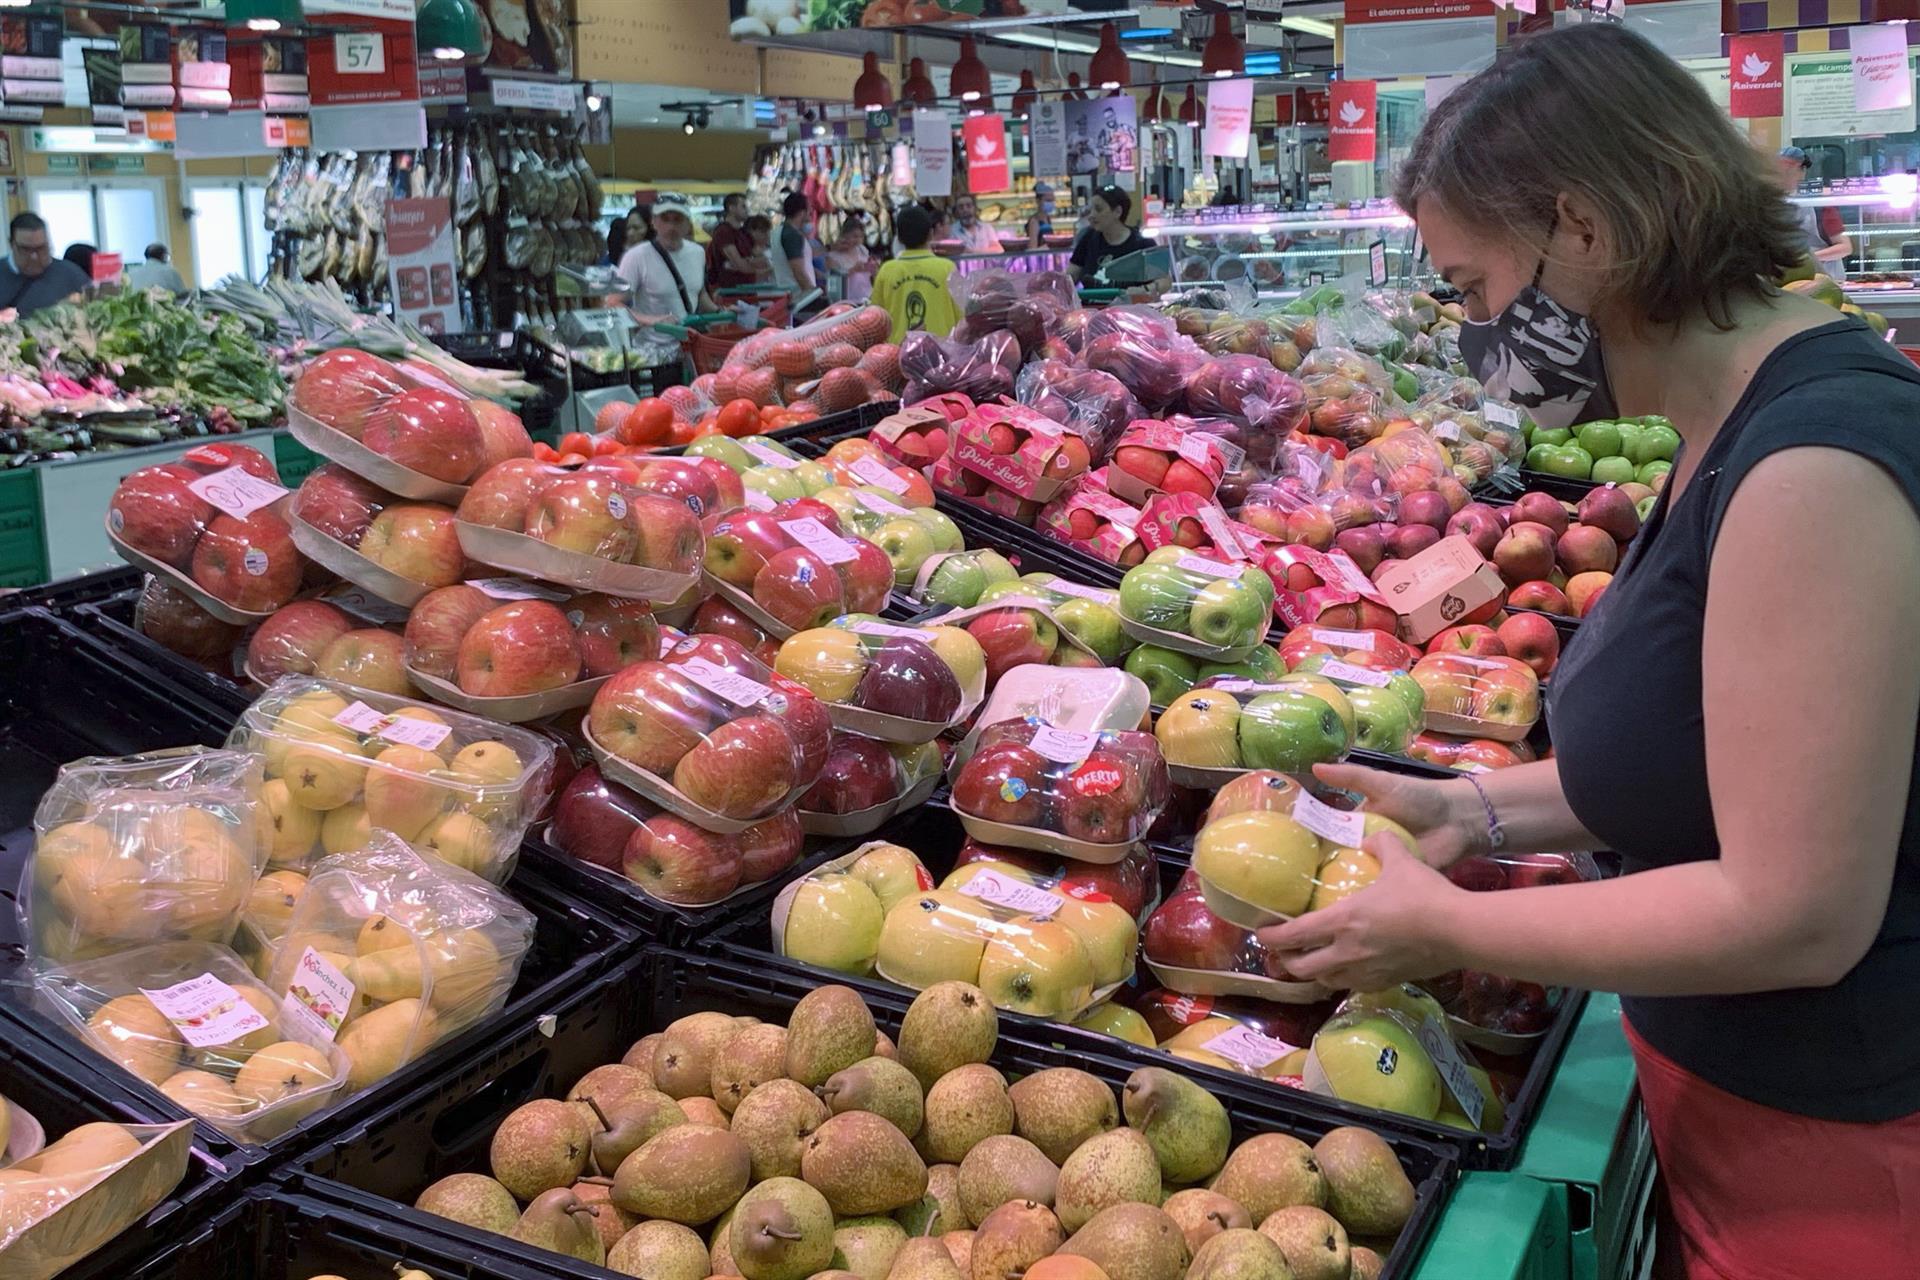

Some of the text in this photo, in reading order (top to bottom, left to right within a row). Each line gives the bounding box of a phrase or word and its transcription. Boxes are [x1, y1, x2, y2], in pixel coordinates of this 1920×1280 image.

[1378, 8, 1405, 17] ahorro
[1445, 3, 1470, 14] precio
[347, 45, 373, 67] 57
[1856, 52, 1904, 63] Aniversario
[1733, 81, 1782, 89] Aniversario
[1331, 125, 1374, 134] Aniversario
[960, 445, 1028, 488] Pink Lady
[1076, 769, 1120, 790] OFERTA
